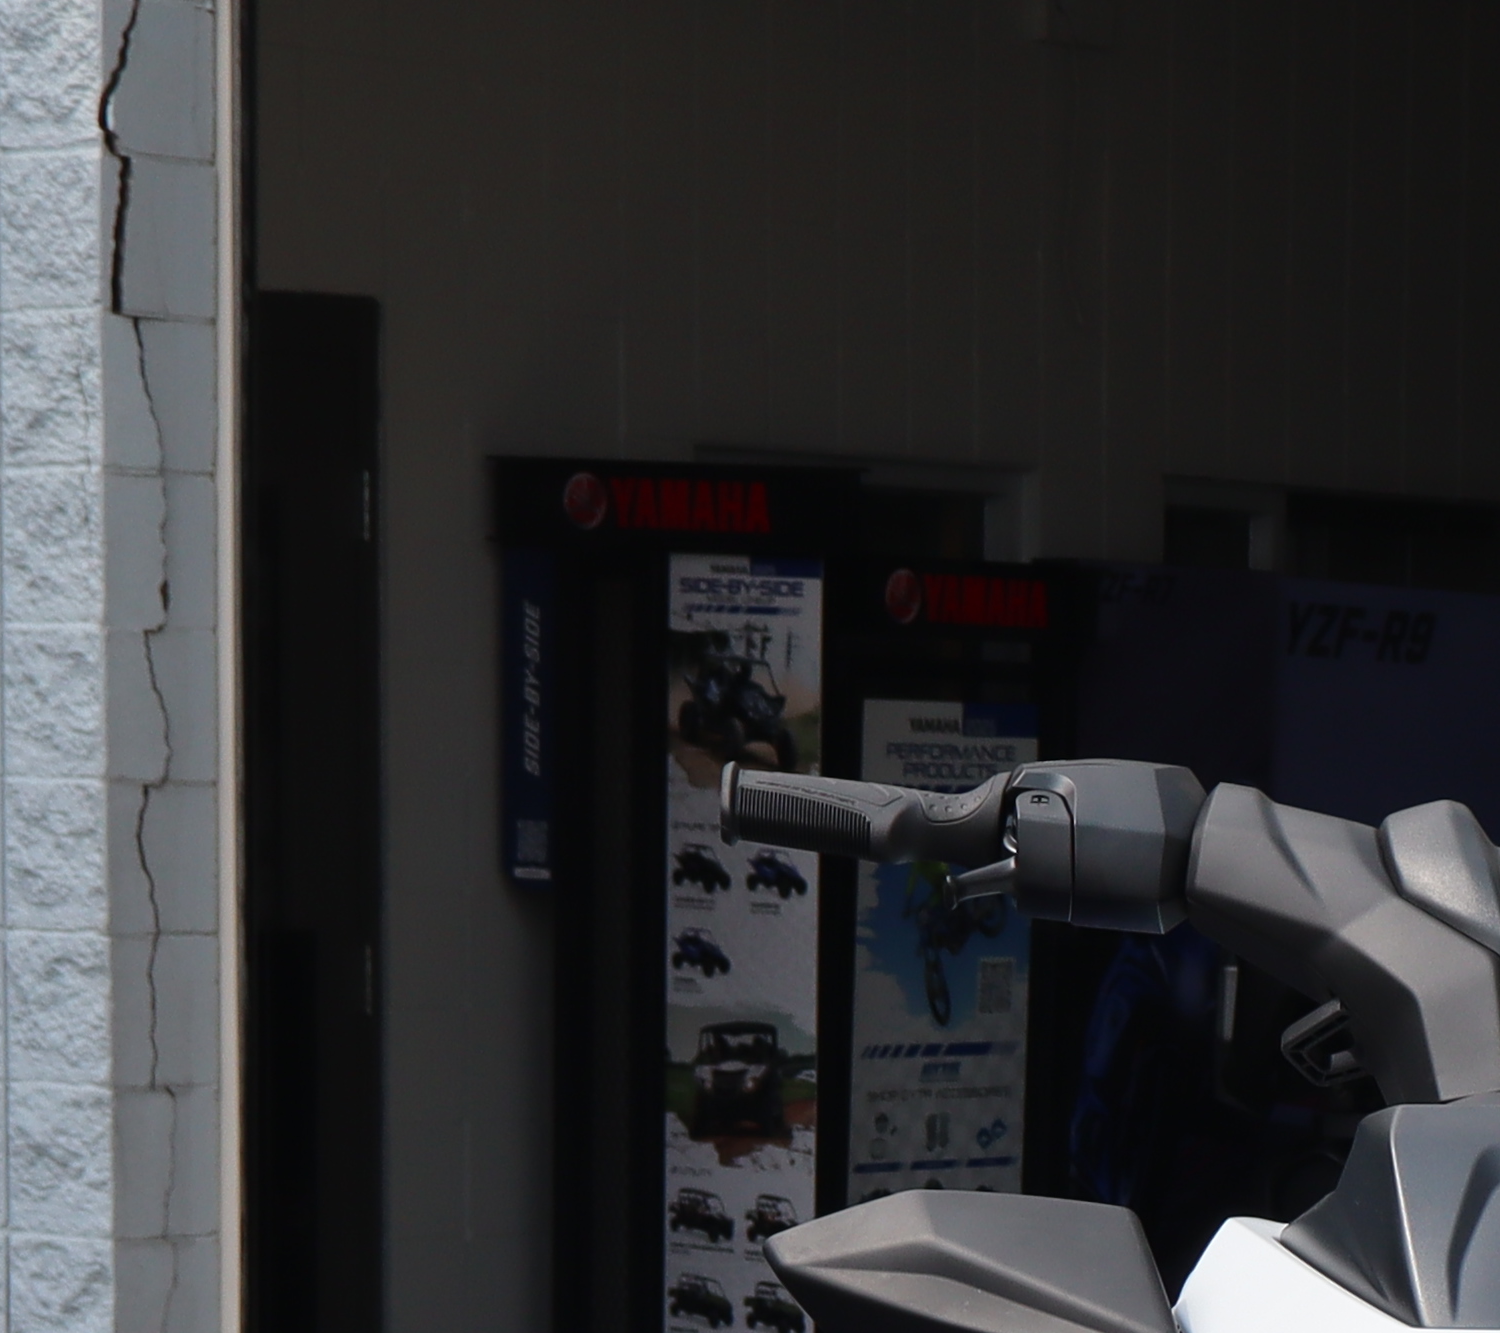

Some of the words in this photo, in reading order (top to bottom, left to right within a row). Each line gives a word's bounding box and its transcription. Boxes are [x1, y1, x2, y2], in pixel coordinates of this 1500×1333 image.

[611, 477, 772, 534] YAMAHA
[679, 576, 805, 597] SIDE-BY-SIDE
[923, 573, 1050, 629] YAMAHA
[1100, 572, 1178, 606] ZF-R7
[1287, 601, 1438, 665] YZF-R9
[522, 599, 541, 778] SIDE-BY-SIDE
[908, 717, 960, 734] YAMAHA
[886, 742, 1016, 762] PERFORMANCE
